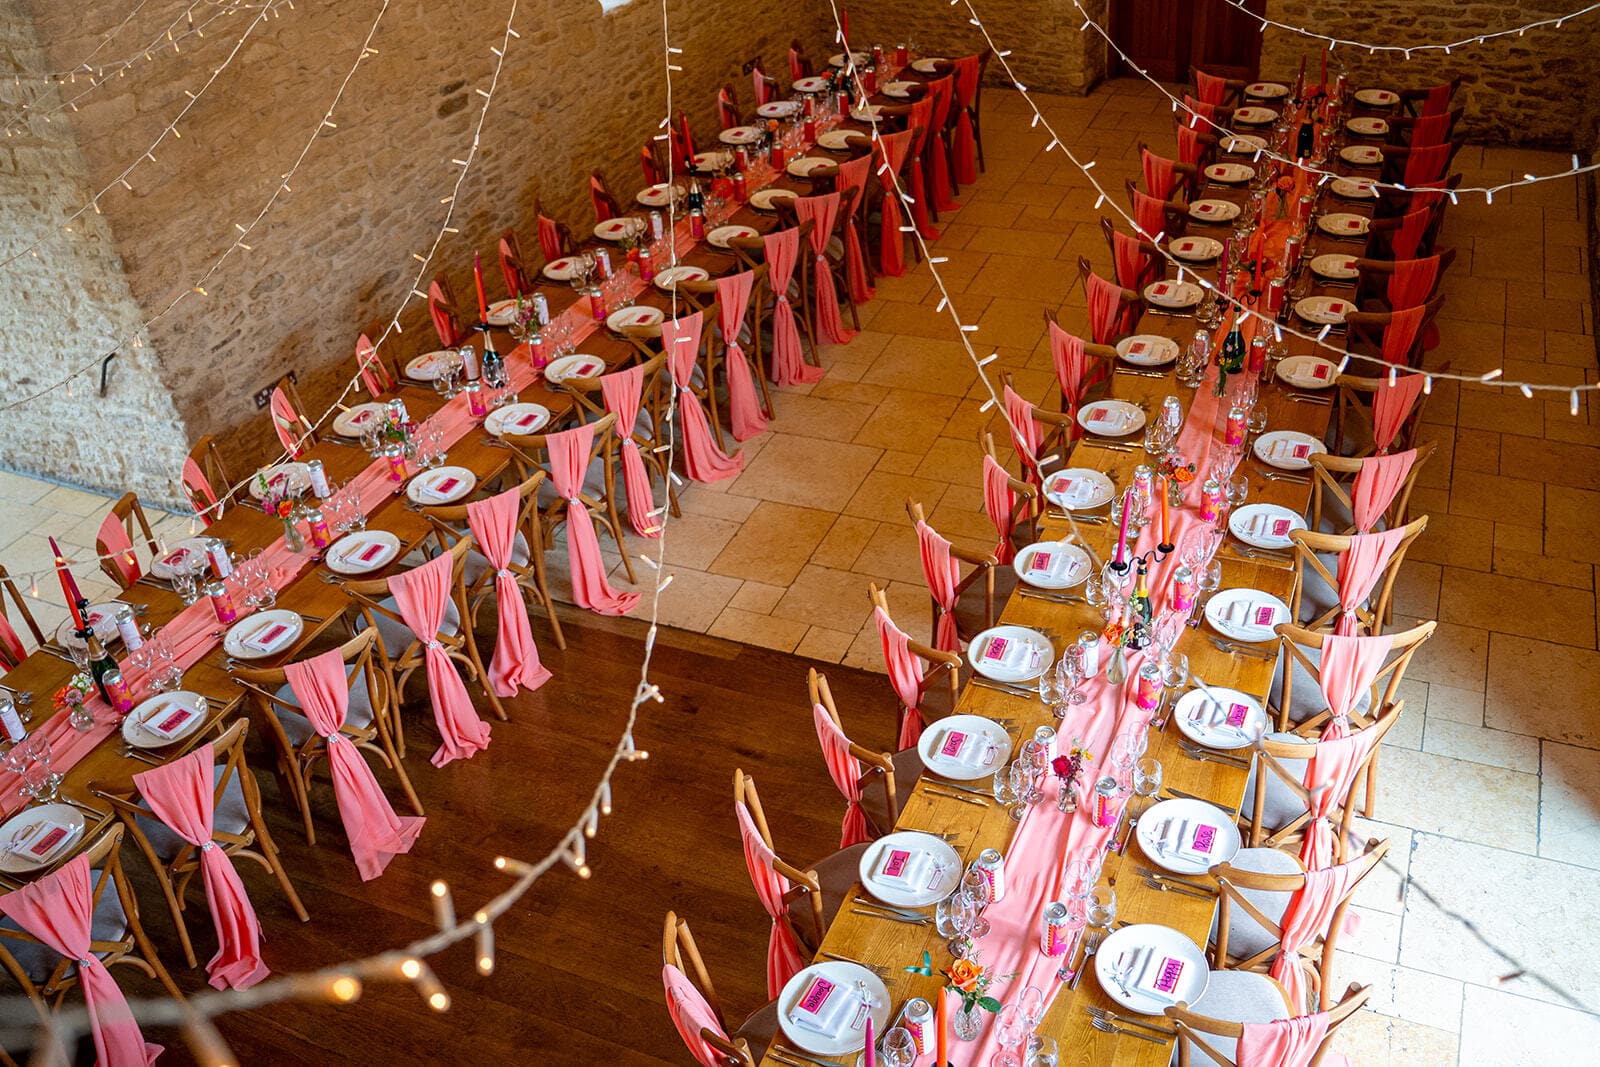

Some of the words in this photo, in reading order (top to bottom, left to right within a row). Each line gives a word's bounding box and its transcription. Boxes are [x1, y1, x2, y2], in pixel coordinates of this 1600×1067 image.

[1194, 829, 1214, 850] Rose
[1156, 962, 1181, 989] Poppy
[808, 980, 832, 1009] Joanna
